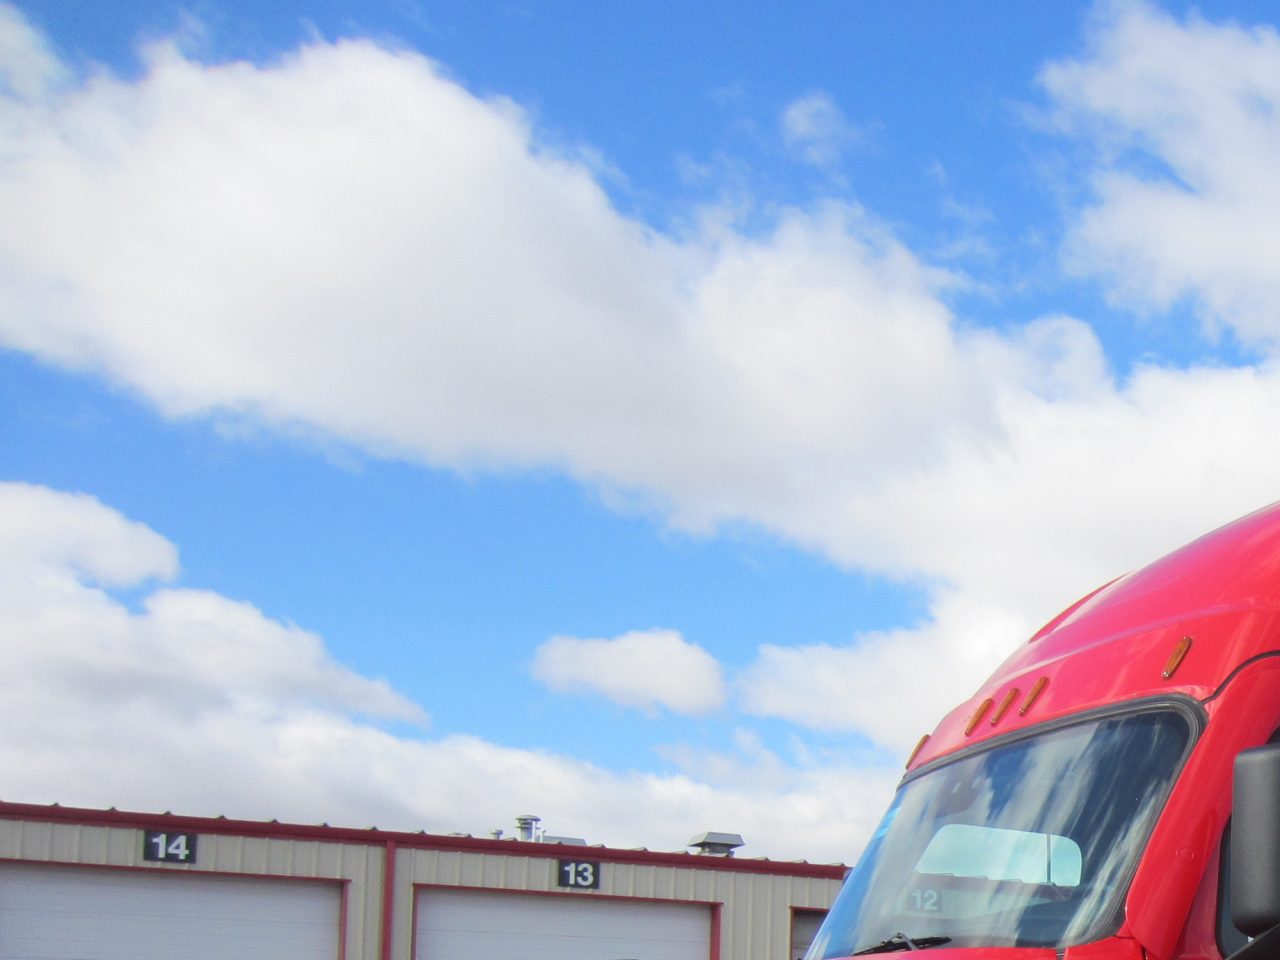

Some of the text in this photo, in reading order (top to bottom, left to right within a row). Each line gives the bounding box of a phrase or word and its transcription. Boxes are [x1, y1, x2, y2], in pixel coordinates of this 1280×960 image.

[152, 833, 190, 860] 14
[564, 862, 594, 886] 13
[912, 889, 938, 911] 12
